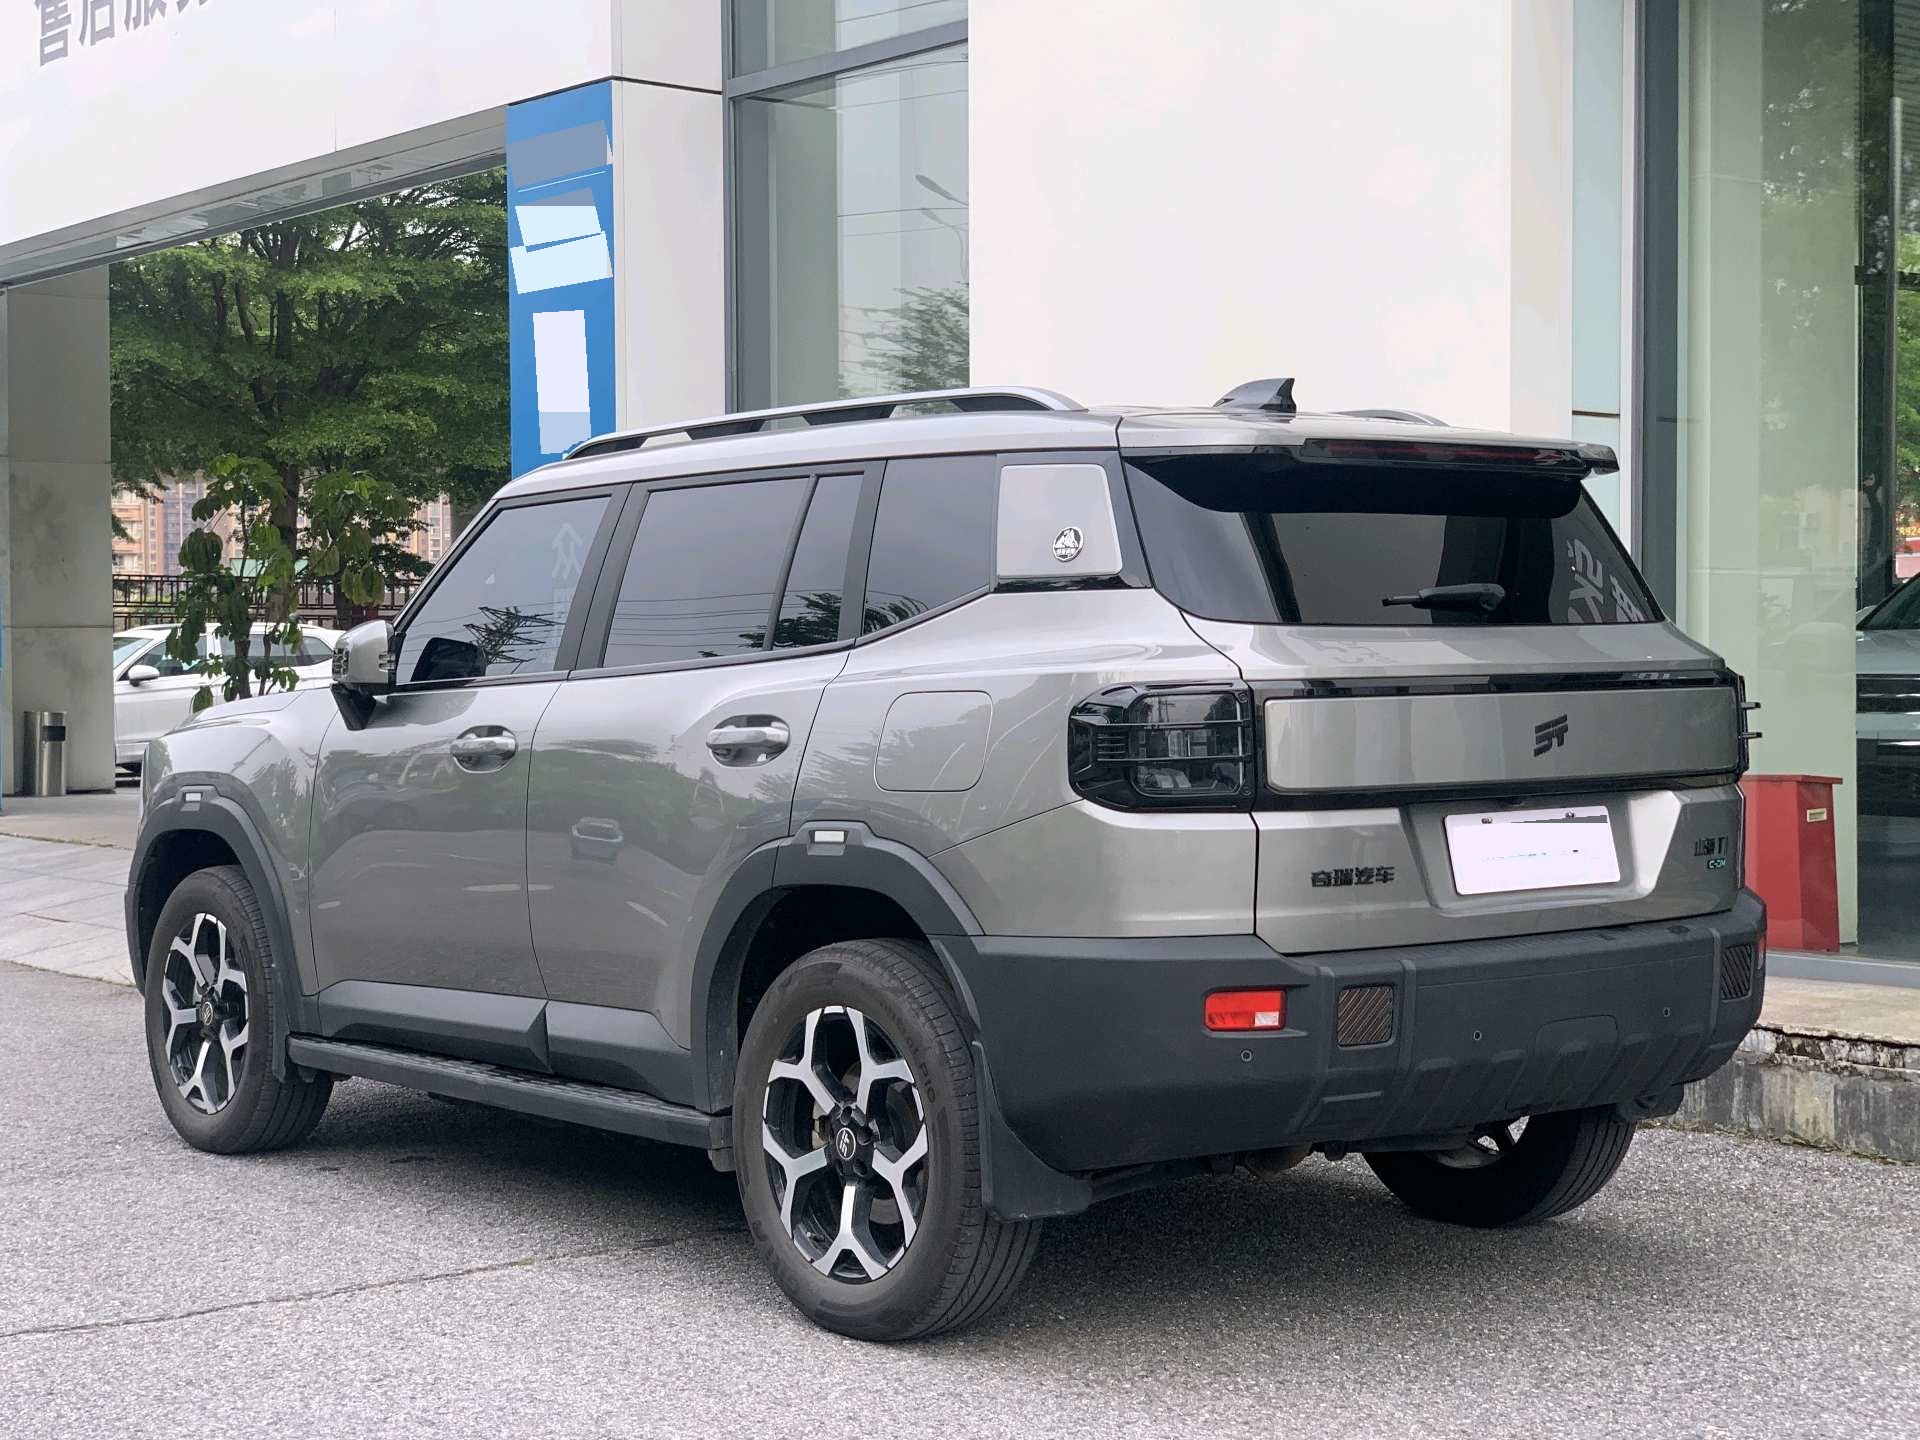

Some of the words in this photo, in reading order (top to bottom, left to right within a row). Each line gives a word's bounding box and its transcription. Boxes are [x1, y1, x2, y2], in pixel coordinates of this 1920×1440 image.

[34, 0, 209, 67] 售后
[1311, 866, 1395, 888] 奇瑞汽车
